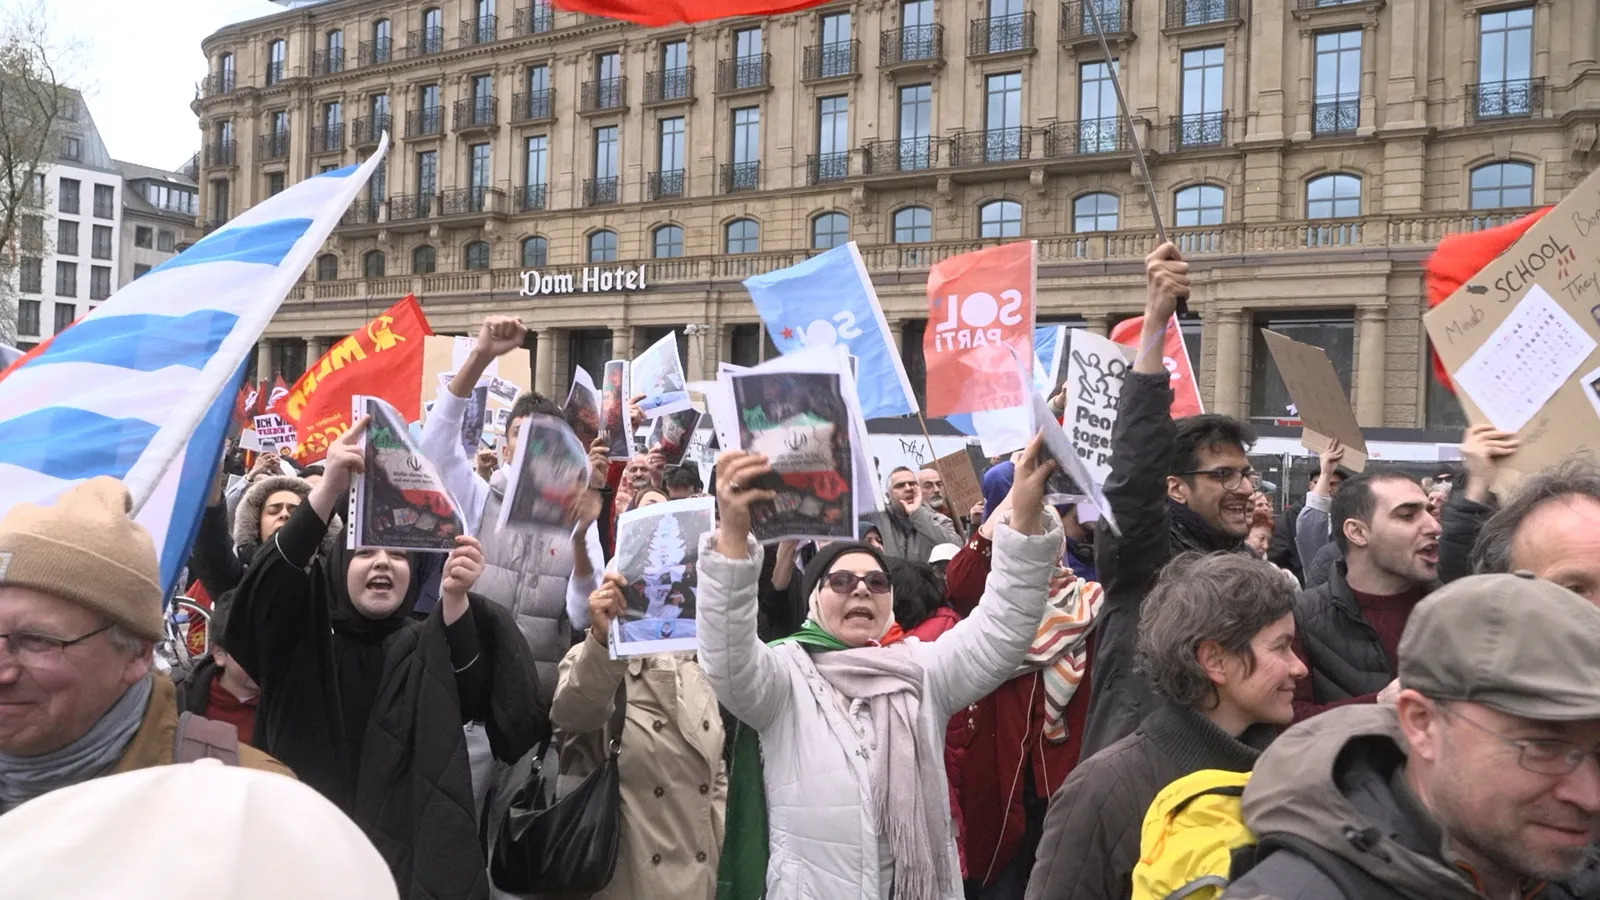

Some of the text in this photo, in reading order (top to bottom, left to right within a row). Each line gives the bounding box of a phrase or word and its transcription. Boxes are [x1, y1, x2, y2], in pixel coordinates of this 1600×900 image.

[520, 264, 647, 297] Dom Hotel
[1494, 235, 1570, 303] SCHOOL
[1561, 271, 1600, 302] They
[256, 417, 272, 428] ICH
[1075, 405, 1116, 431] Peo
